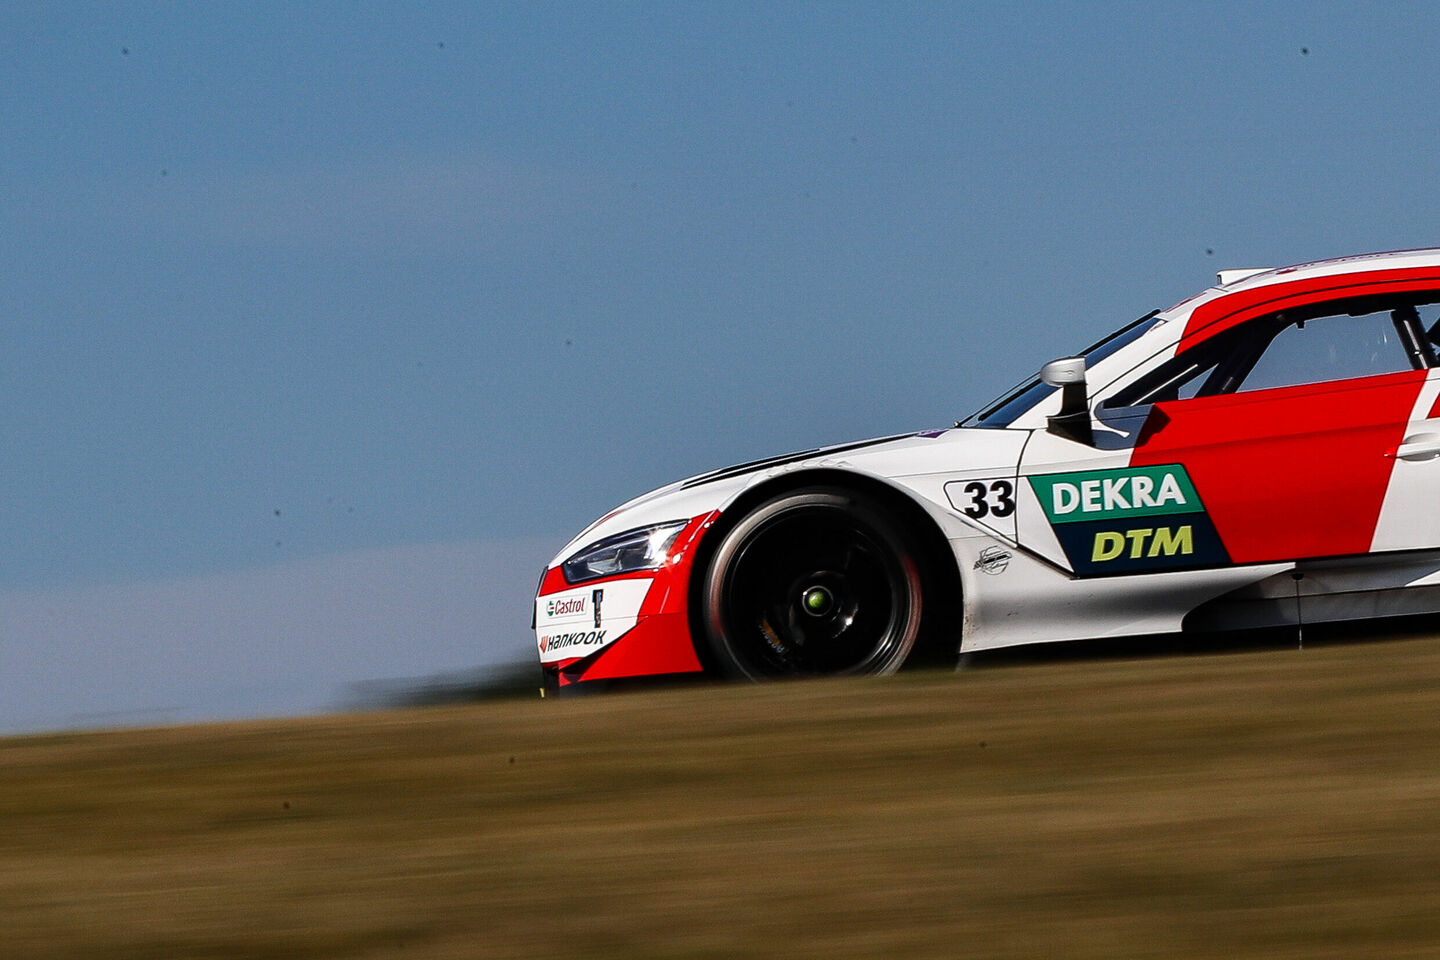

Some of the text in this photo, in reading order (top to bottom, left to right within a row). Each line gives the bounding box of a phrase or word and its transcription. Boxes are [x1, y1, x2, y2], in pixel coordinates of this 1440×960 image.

[963, 480, 1016, 520] 33
[1052, 473, 1187, 515] DEKRA
[1091, 525, 1193, 563] DTM
[554, 597, 586, 616] Castrol
